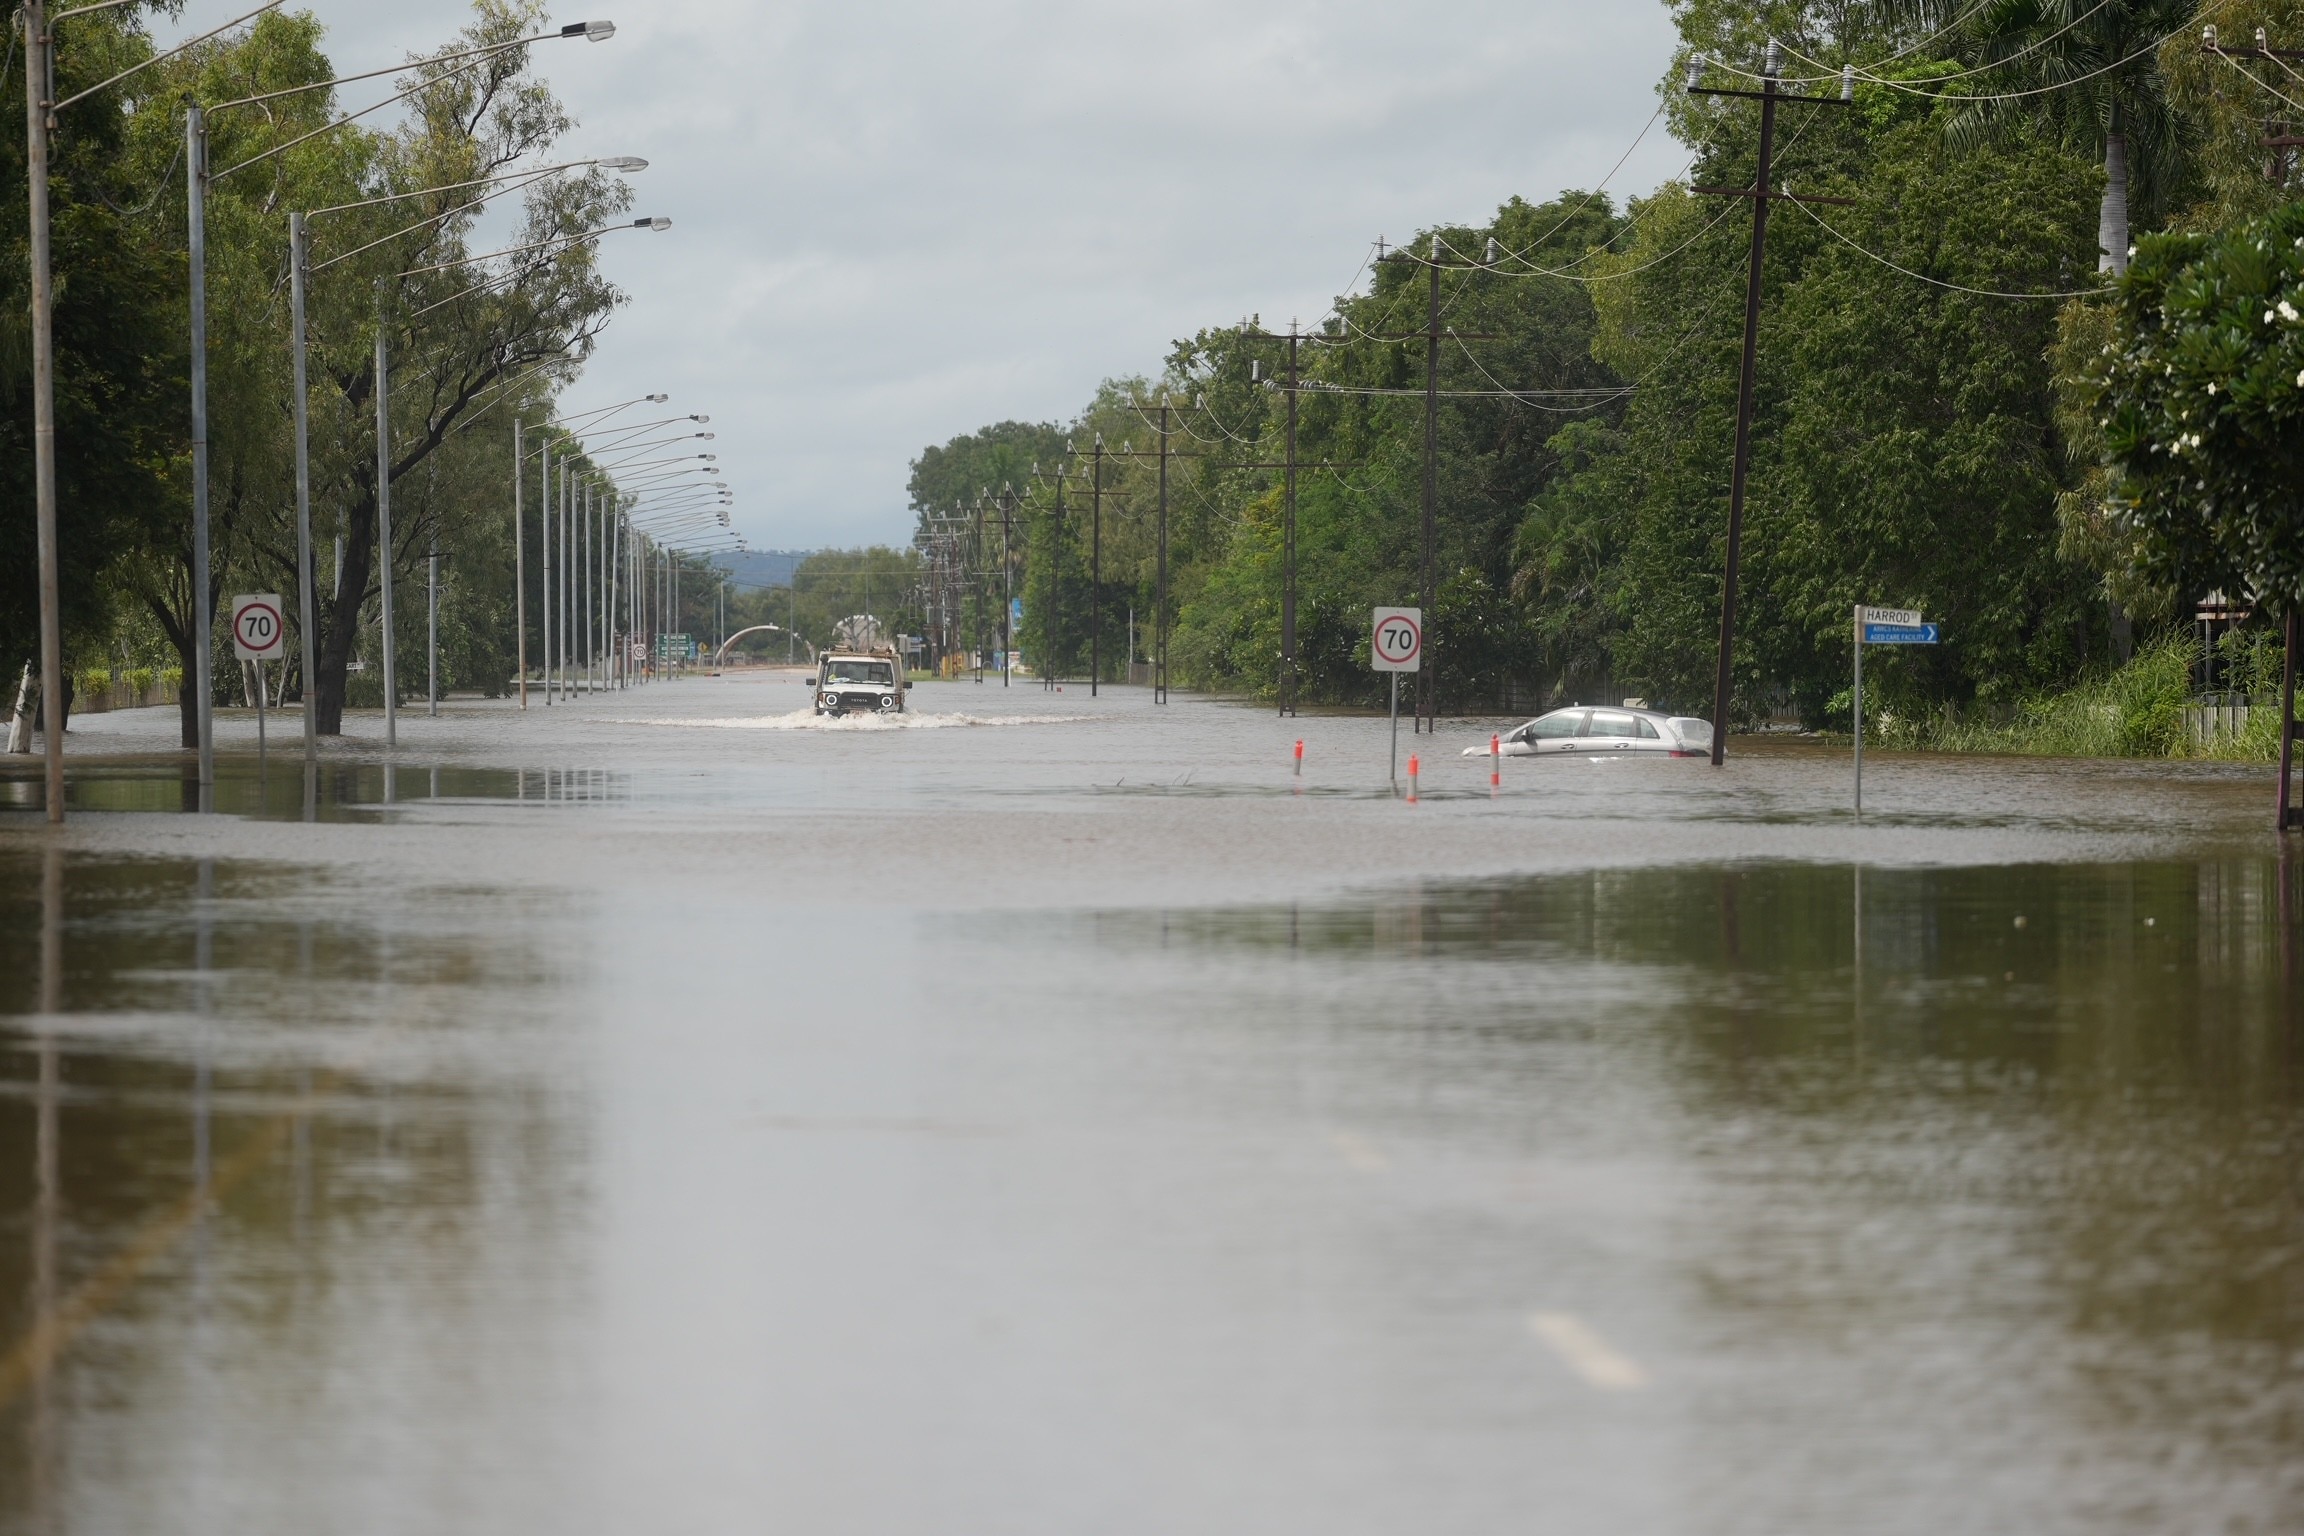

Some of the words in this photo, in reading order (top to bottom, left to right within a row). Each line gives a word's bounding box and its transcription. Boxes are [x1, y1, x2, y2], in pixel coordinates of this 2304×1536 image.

[1867, 609, 1910, 623] HARROD
[245, 616, 270, 637] 70
[1384, 629, 1412, 650] 70
[1870, 633, 1885, 641] AGED
[1886, 633, 1900, 641] CARE
[1901, 633, 1925, 641] FACILITY
